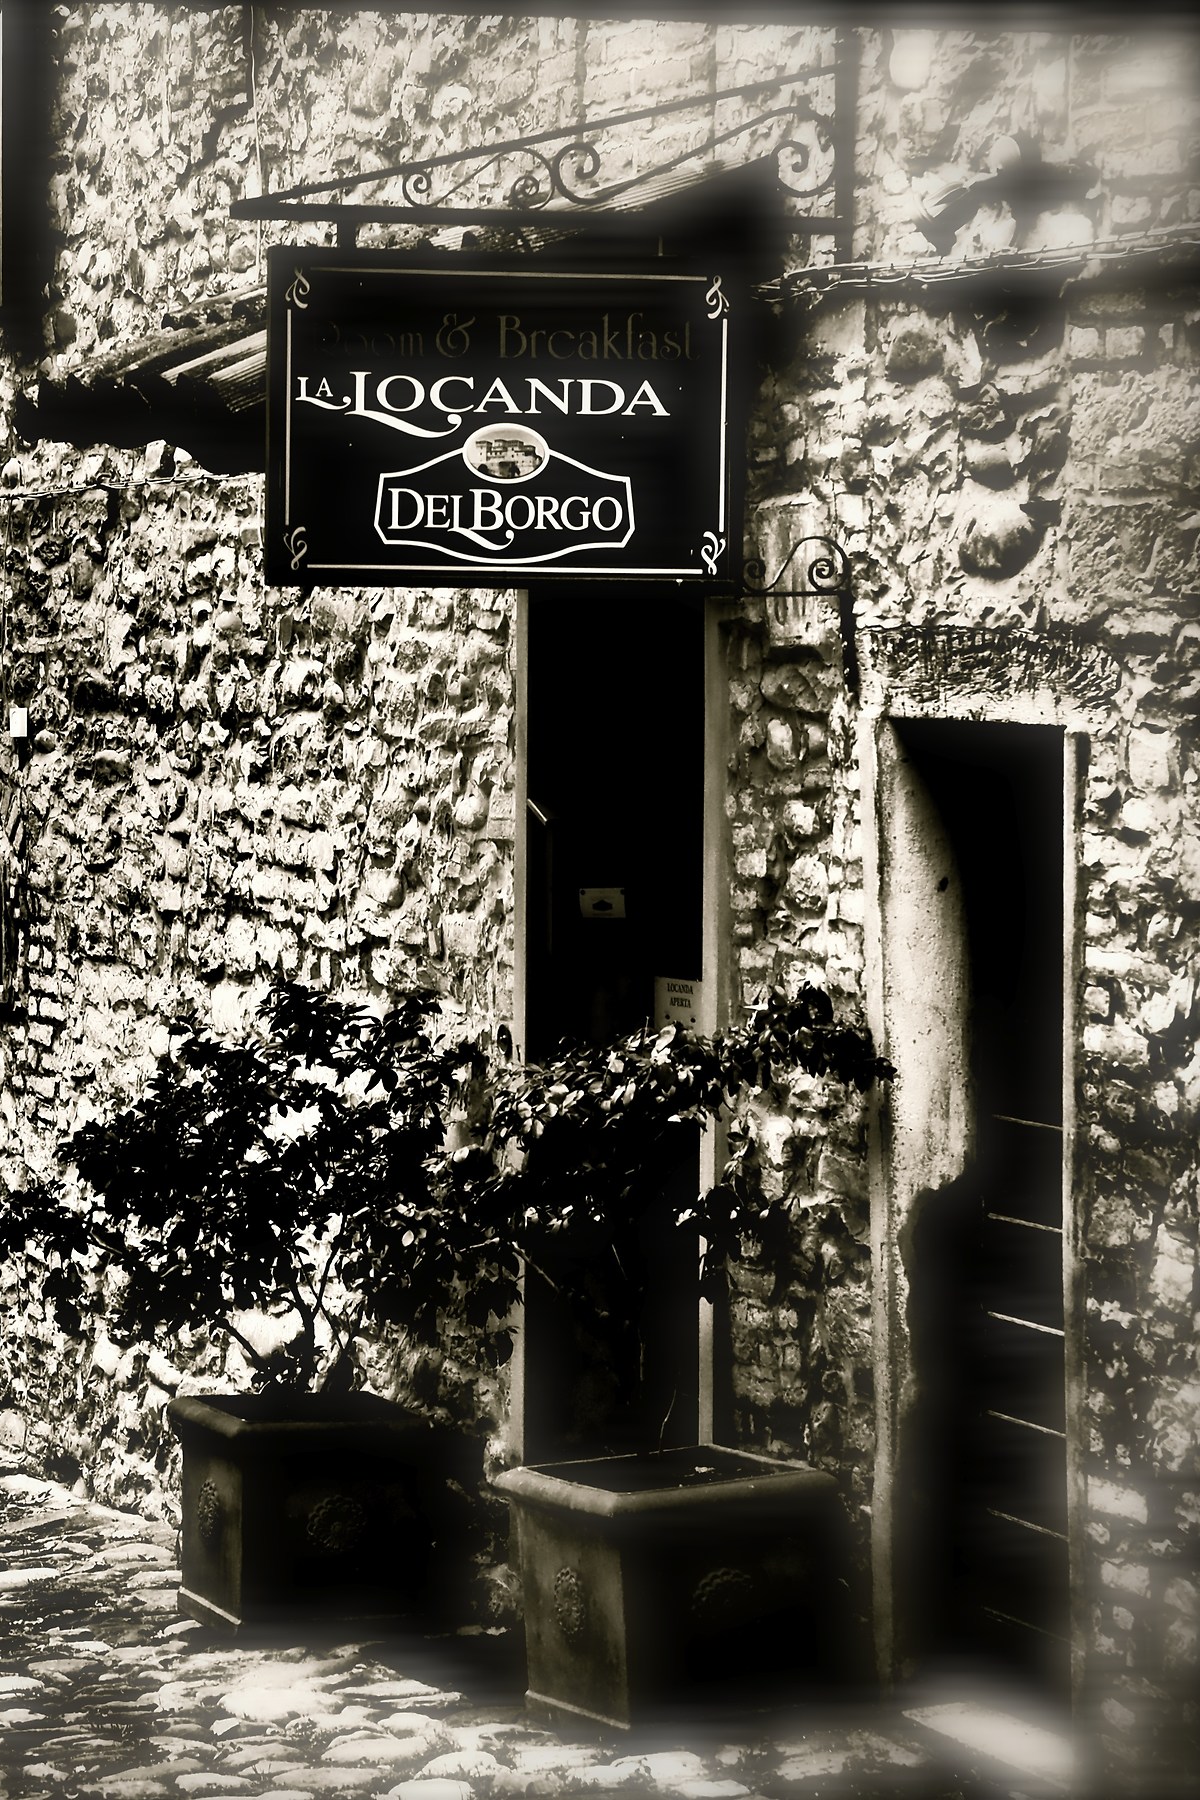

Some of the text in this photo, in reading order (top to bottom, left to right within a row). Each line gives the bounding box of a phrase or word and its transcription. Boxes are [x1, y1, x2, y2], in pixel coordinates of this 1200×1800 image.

[435, 312, 477, 359] &
[498, 312, 700, 361] Breakfast
[295, 370, 671, 439] LA LOCANDA
[666, 982, 694, 995] LOCANDA
[670, 996, 692, 1009] APERTA
